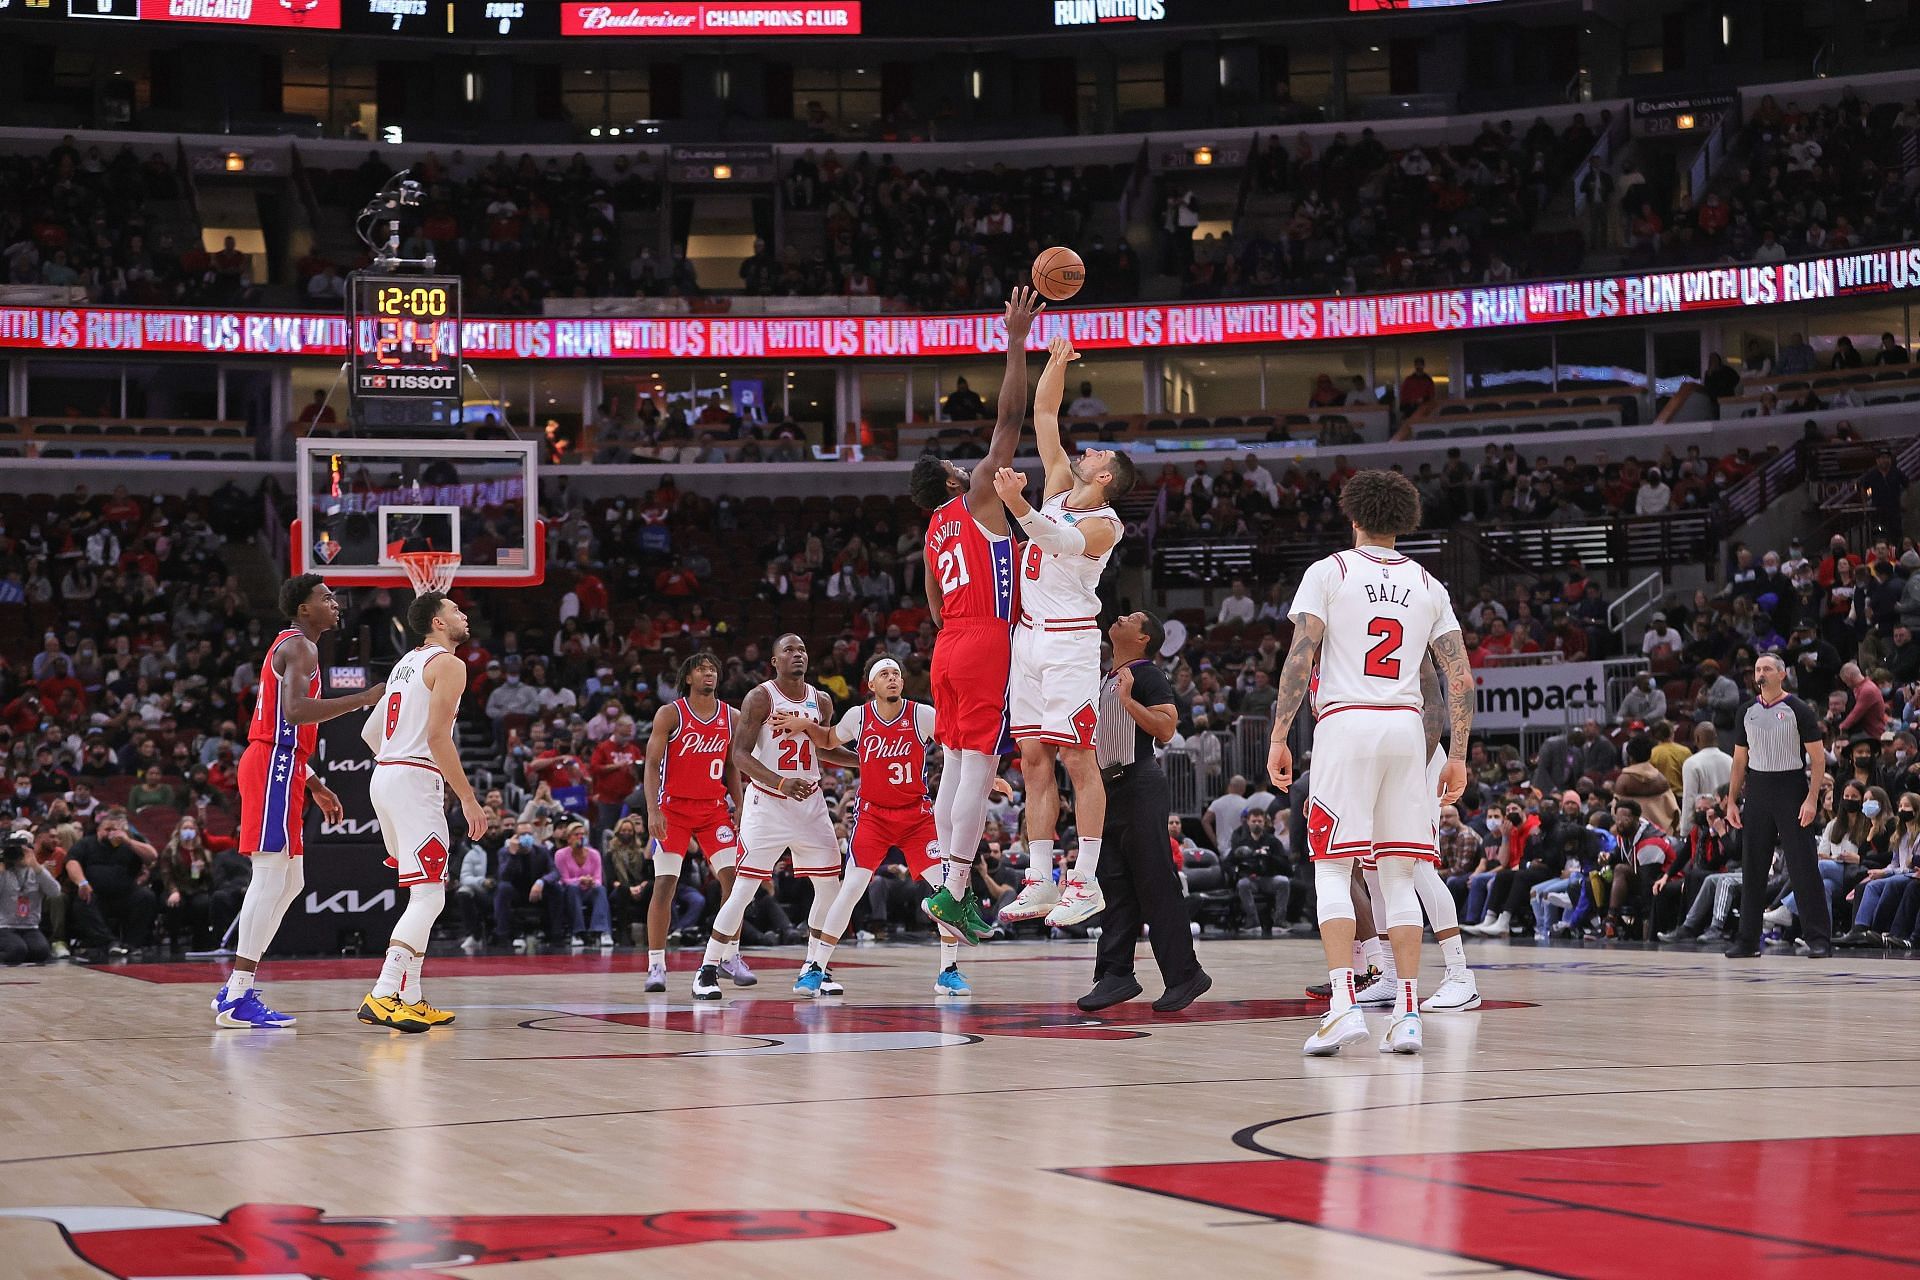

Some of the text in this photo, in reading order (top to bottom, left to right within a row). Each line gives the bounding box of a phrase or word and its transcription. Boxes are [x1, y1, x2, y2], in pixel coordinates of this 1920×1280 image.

[392, 14, 403, 30] 7
[578, 6, 849, 28] Budweiser CHAMPIONS CLUB
[1054, 0, 1097, 25] RUN
[1137, 0, 1166, 20] US
[378, 287, 446, 315] 12:00
[514, 321, 550, 357] US
[556, 321, 611, 357] RUN
[614, 321, 666, 349] WITH
[669, 321, 704, 356] US
[709, 320, 765, 355] RUN
[767, 320, 820, 348] WITH
[822, 319, 858, 354] US
[864, 319, 919, 354] RUN
[921, 317, 973, 346] WITH
[1071, 311, 1124, 340] WITH
[1127, 309, 1162, 345] US
[1167, 305, 1223, 343] RUN
[1224, 303, 1277, 334] WITH
[1281, 301, 1317, 339] US
[1322, 299, 1377, 337] RUN
[1379, 295, 1429, 326] WITH
[1431, 291, 1467, 329] US
[1472, 286, 1526, 326] RUN
[1528, 281, 1580, 313] WITH
[1583, 278, 1619, 317] US
[1624, 273, 1681, 315] RUN
[1682, 268, 1738, 302] WITH
[1740, 265, 1778, 305] US
[1782, 258, 1834, 302] RUN
[1836, 252, 1888, 287] WITH
[1890, 248, 1920, 288] US
[0, 310, 38, 338] ITH
[41, 310, 79, 347] US
[86, 312, 142, 348] RUN
[144, 313, 198, 342] WITH
[202, 314, 240, 350] US
[376, 317, 439, 364] 24
[387, 375, 455, 389] TISSOT
[929, 520, 961, 554] EMBIID
[937, 542, 970, 595] 21
[1025, 543, 1043, 581] 9
[1365, 583, 1411, 608] BALL
[1364, 616, 1404, 681] 2
[1476, 676, 1598, 718] impact
[385, 691, 402, 741] 8
[680, 732, 726, 757] Phila
[777, 739, 812, 771] 24
[863, 734, 913, 763] Phila
[709, 758, 724, 780] 0
[887, 761, 913, 785] 31
